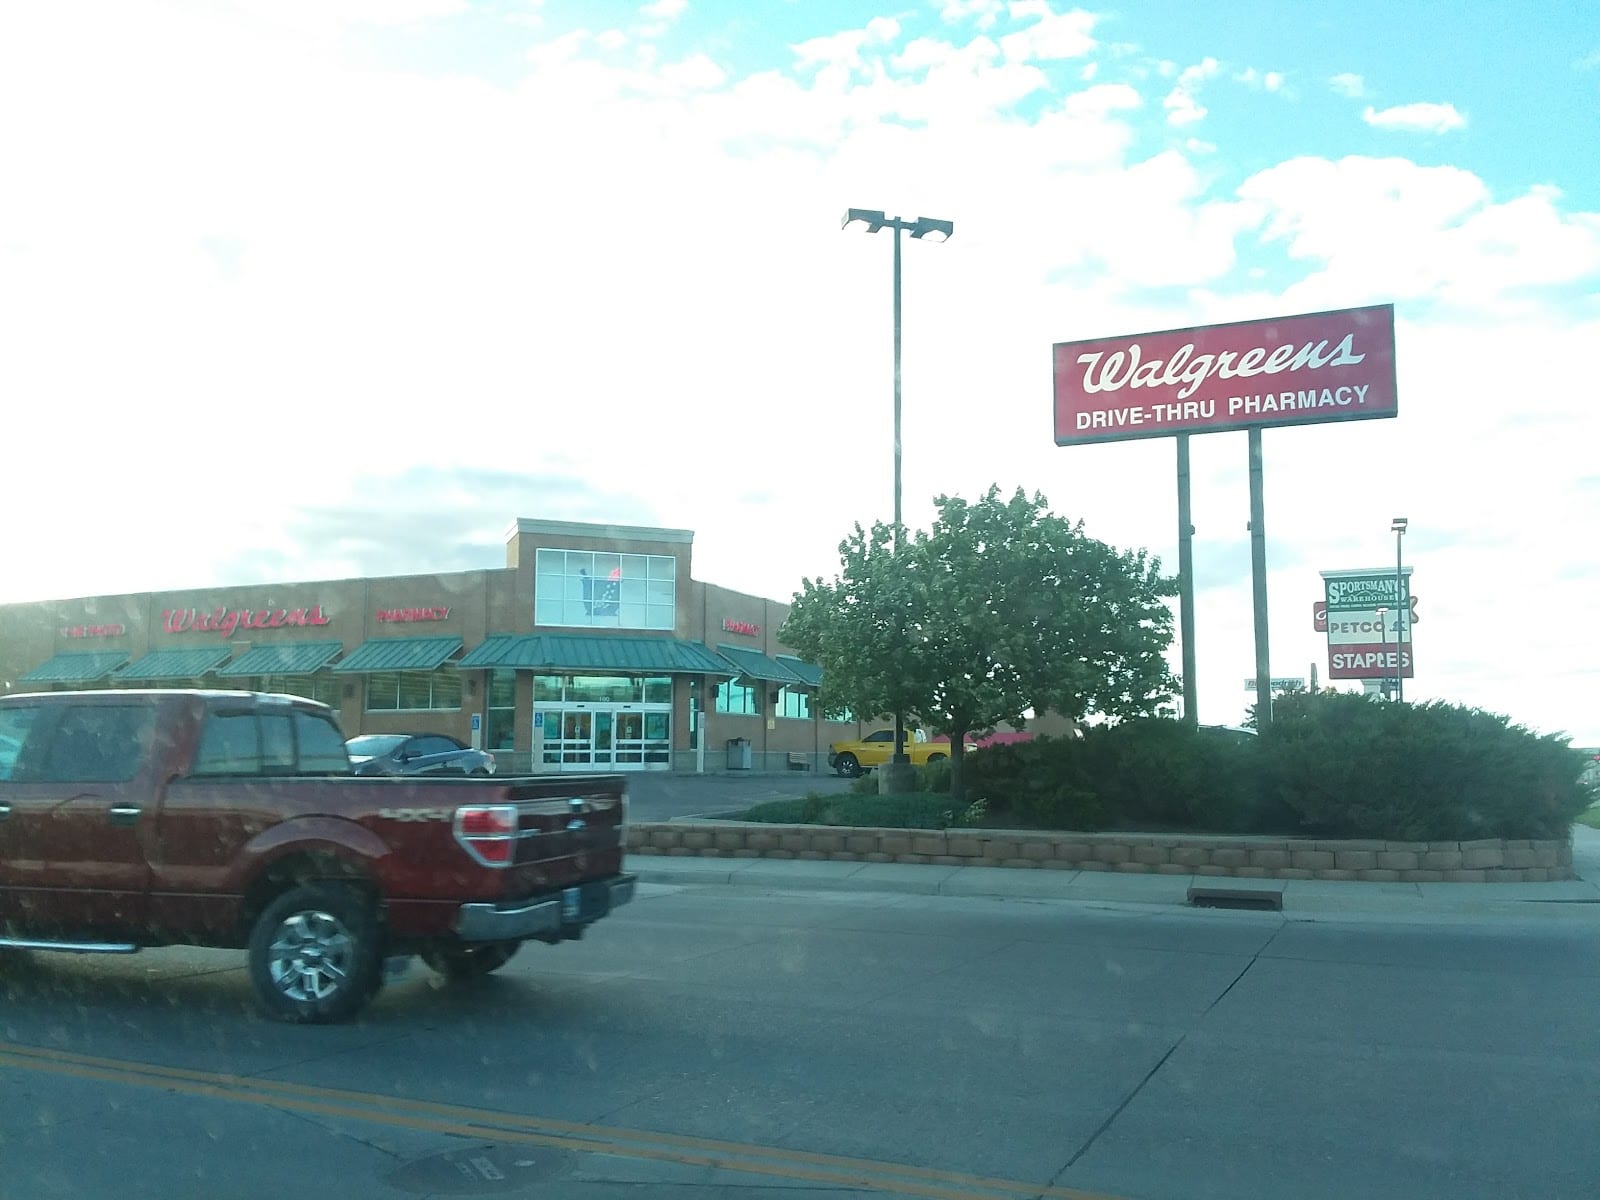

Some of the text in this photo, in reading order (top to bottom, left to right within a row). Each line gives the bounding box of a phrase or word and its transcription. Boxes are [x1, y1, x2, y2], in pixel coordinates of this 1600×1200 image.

[1077, 333, 1366, 400] Walgreens
[1076, 384, 1369, 430] DRIVE-THRU PHARMACY
[1328, 579, 1407, 604] SPORTSMAN'S
[1340, 594, 1394, 603] WAREHOUSE
[161, 604, 331, 639] Walgreens
[1330, 621, 1385, 634] PETCO
[1332, 652, 1410, 669] STAPLES
